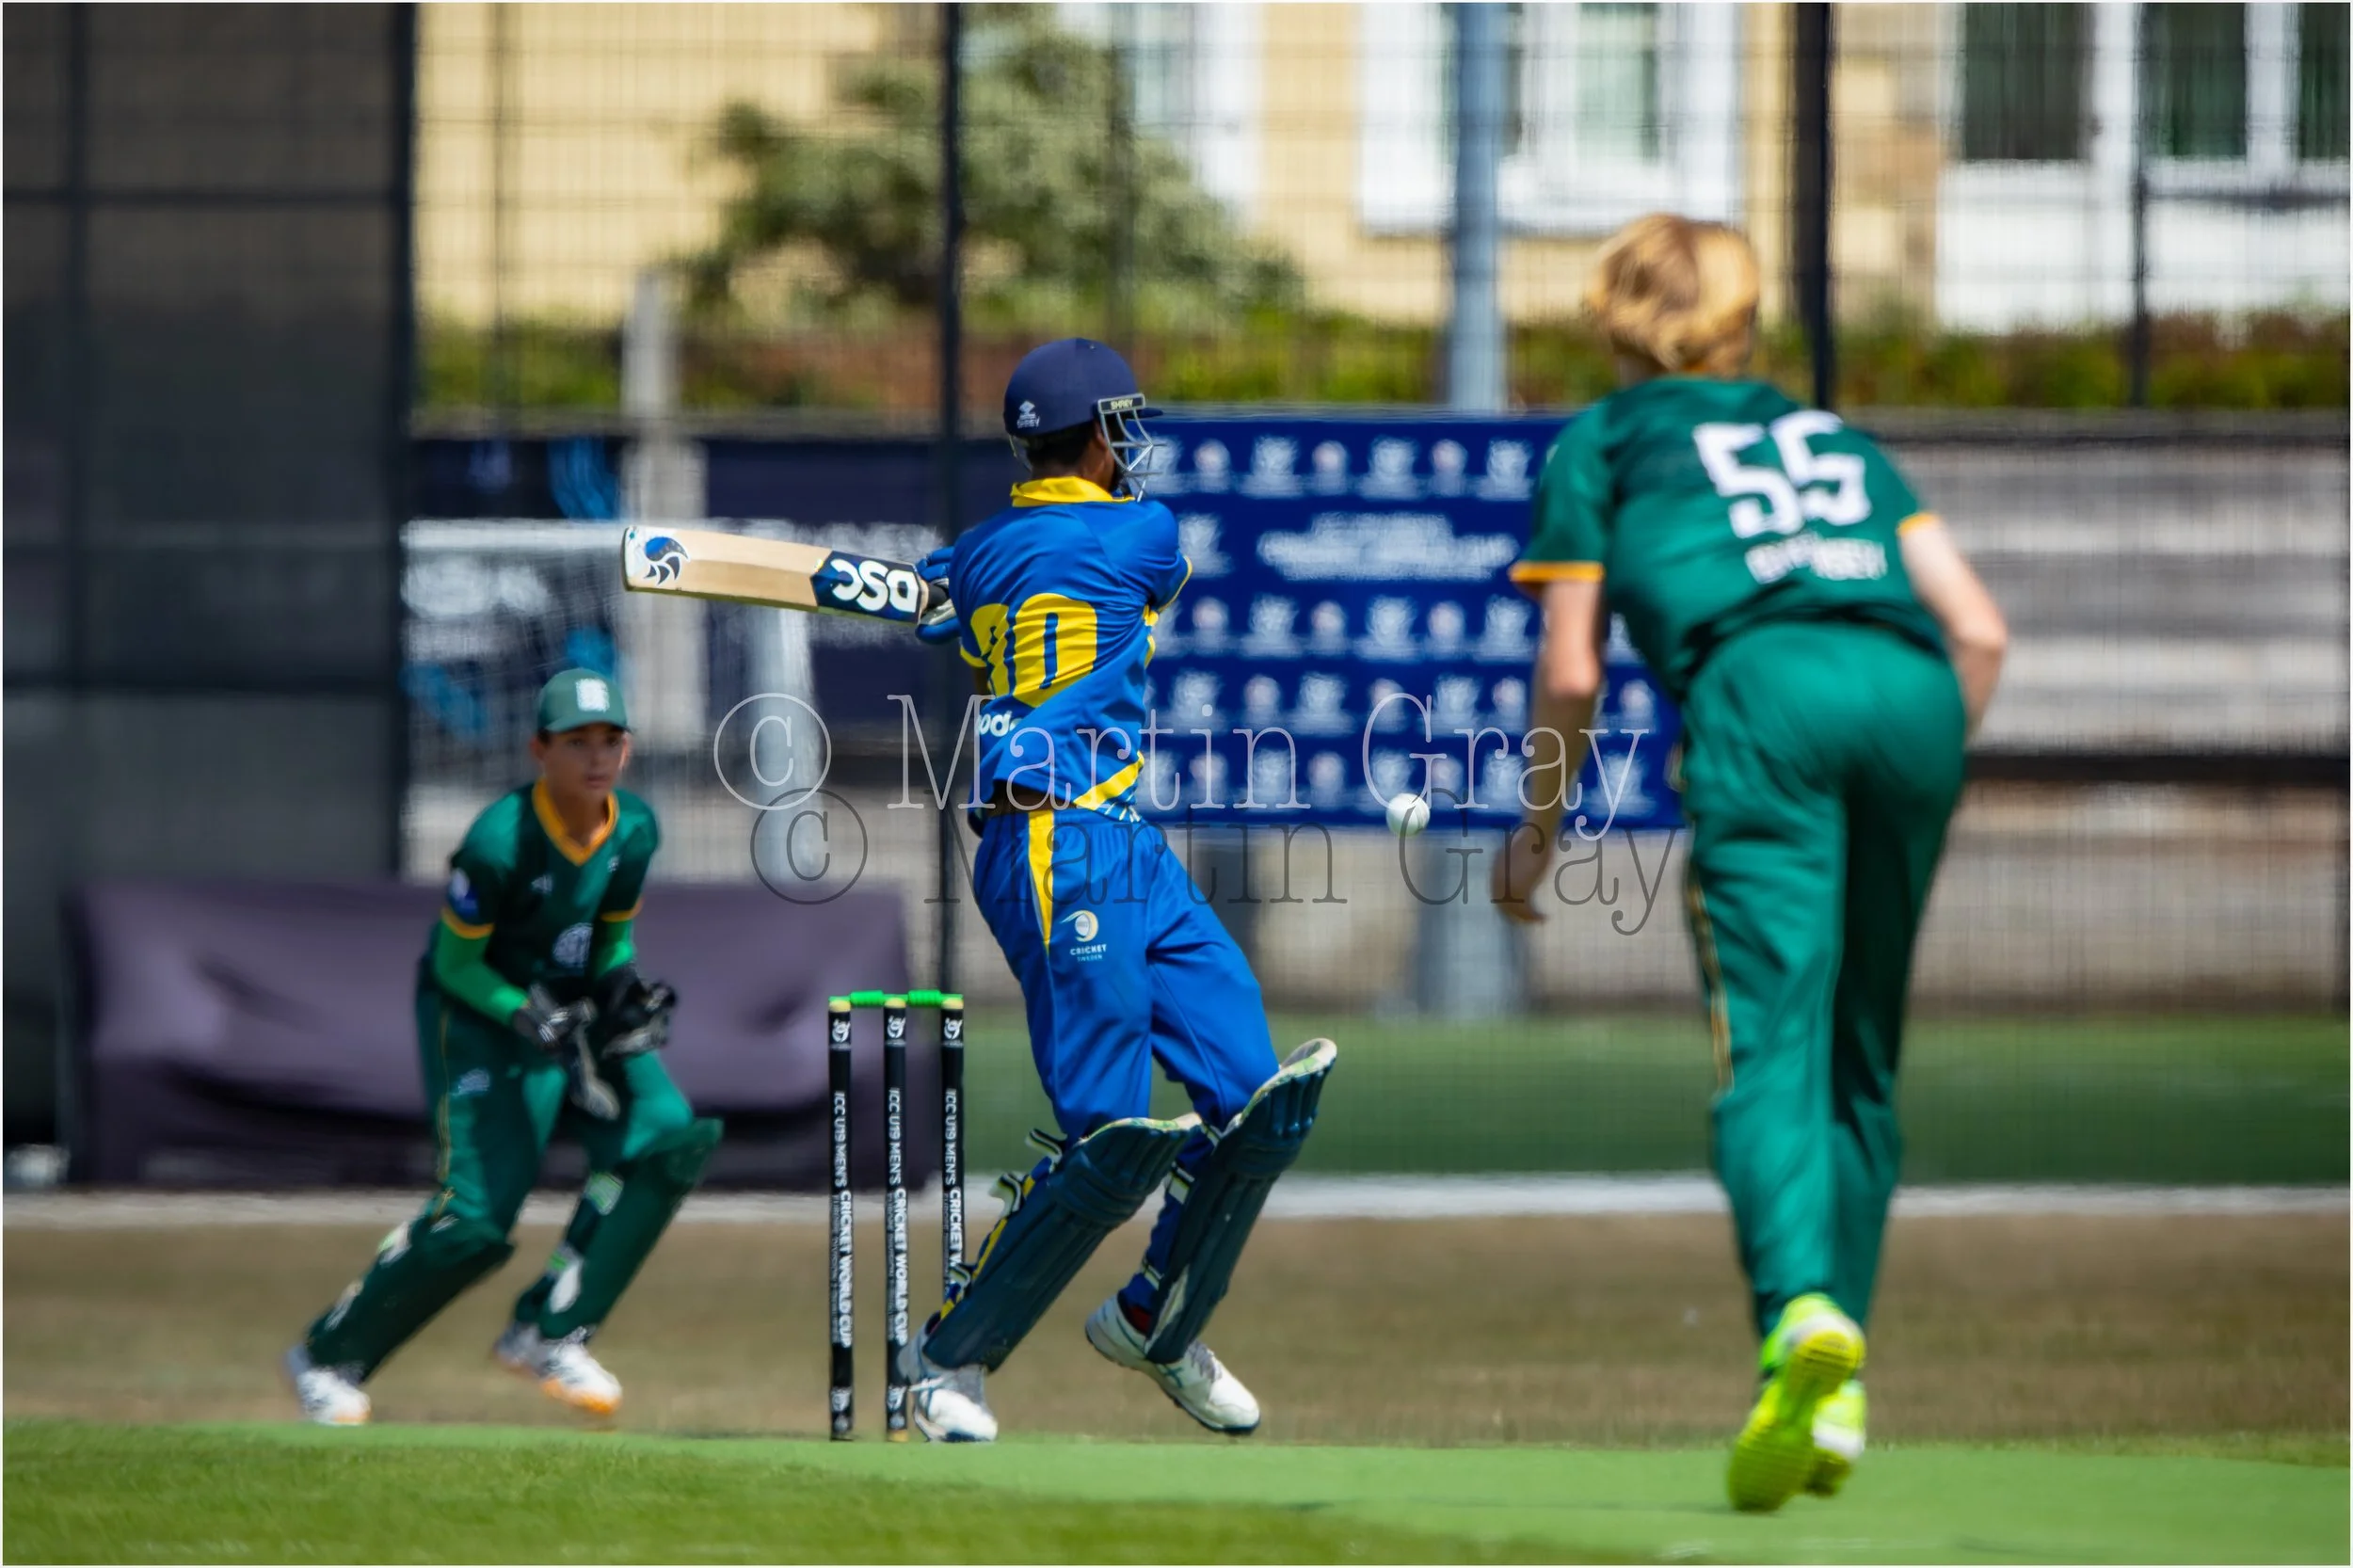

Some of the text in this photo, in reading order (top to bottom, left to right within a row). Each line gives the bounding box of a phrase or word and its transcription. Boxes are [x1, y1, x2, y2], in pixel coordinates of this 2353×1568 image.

[1111, 399, 1133, 410] SHREY
[1692, 409, 1871, 539] 55
[830, 558, 920, 614] DSC
[1069, 944, 1107, 956] CRICKET
[834, 1091, 847, 1188] ICC U19 MEN'S
[888, 1088, 902, 1186] ICC U19 MEN'S
[945, 1089, 957, 1186] ICC U19 MEN'S
[894, 1188, 908, 1346] CRICKET WORLD CUP
[950, 1187, 963, 1251] CRICKET
[839, 1190, 853, 1348] CRICKET WORLD CUP
